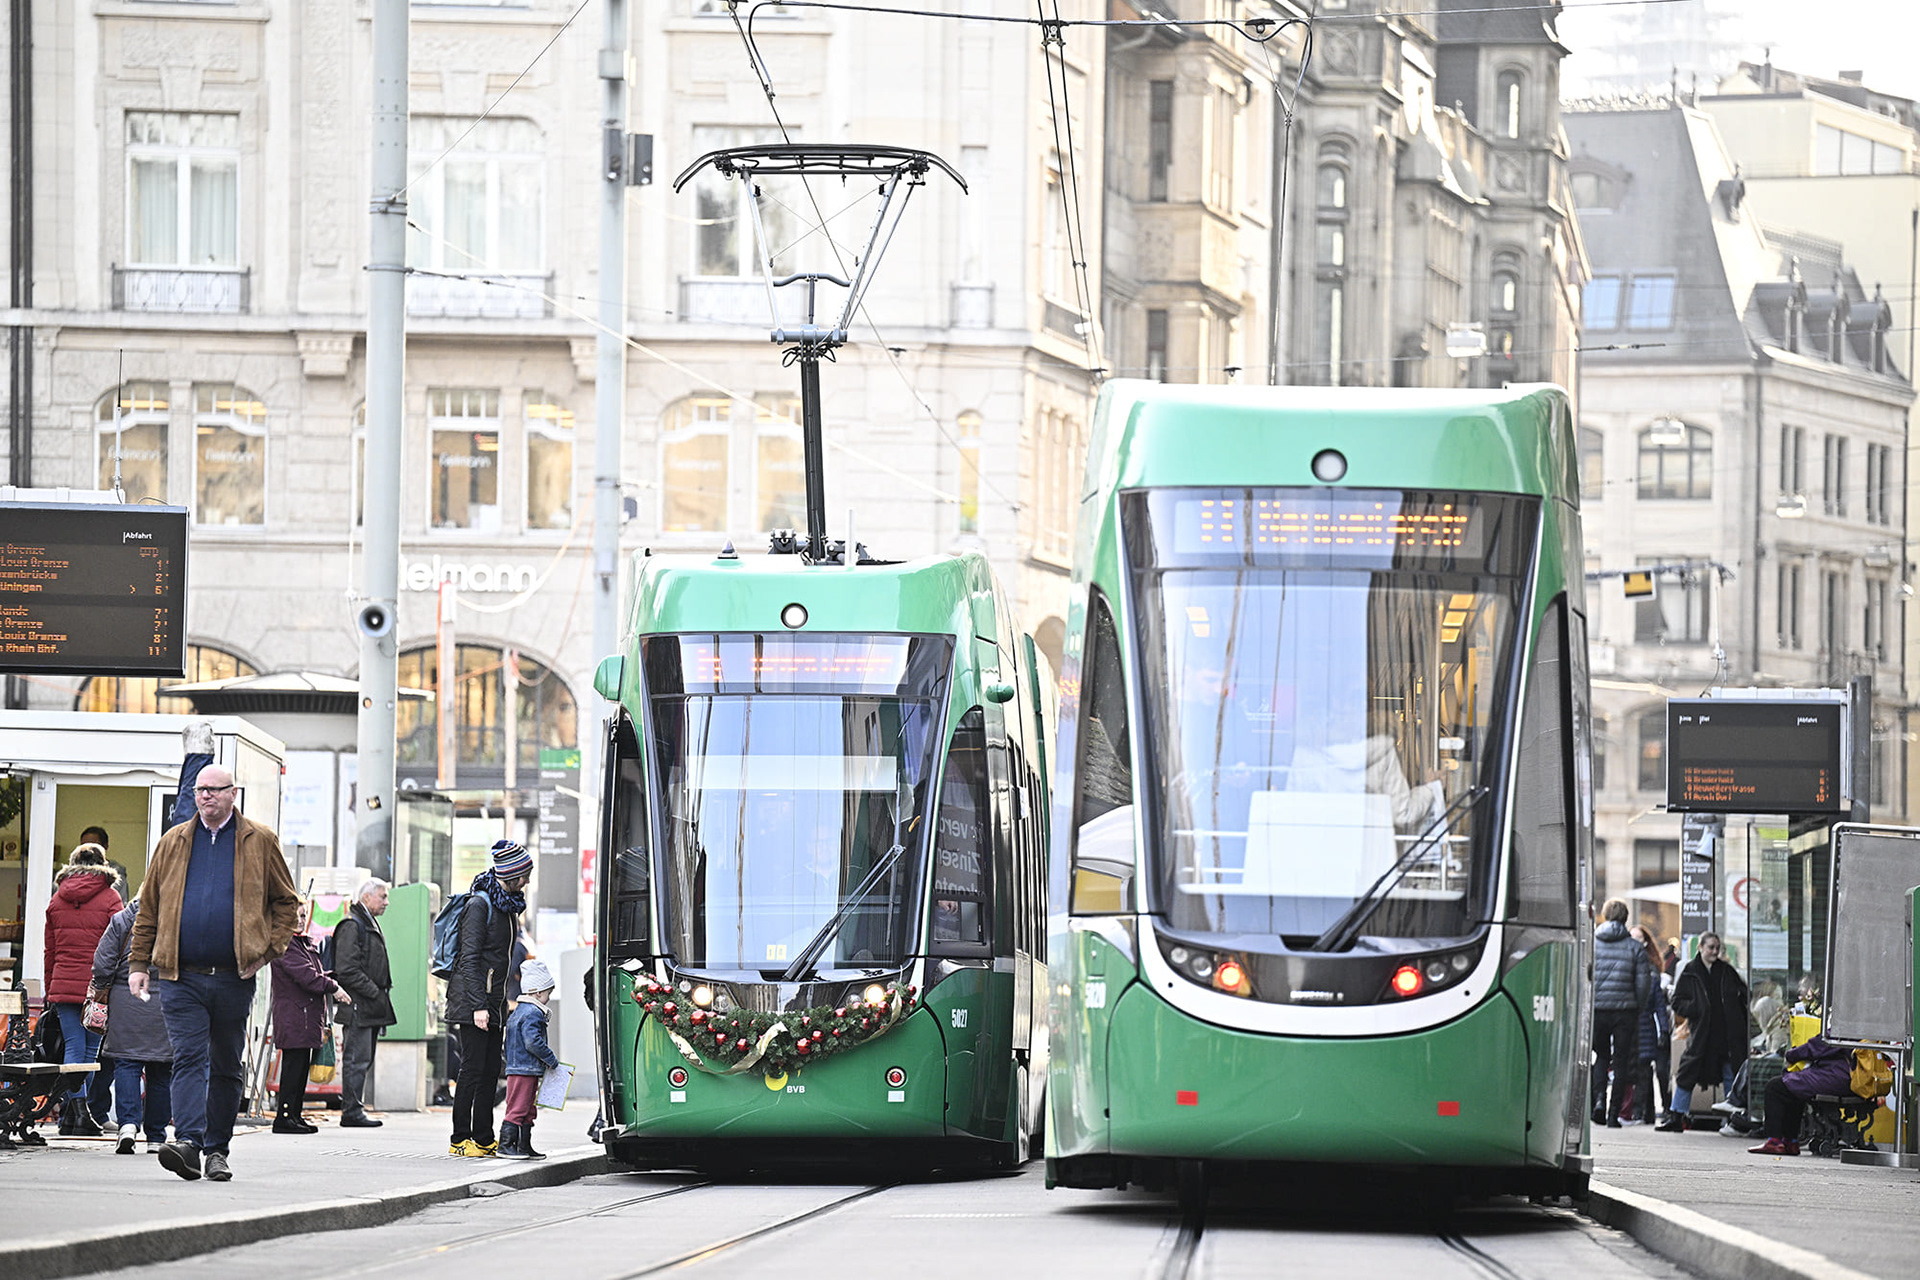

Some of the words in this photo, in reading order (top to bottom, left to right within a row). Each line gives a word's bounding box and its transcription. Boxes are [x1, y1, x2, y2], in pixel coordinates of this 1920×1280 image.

[125, 531, 152, 540] Abfahrt
[951, 1008, 968, 1028] 5027
[786, 1085, 806, 1094] BVB
